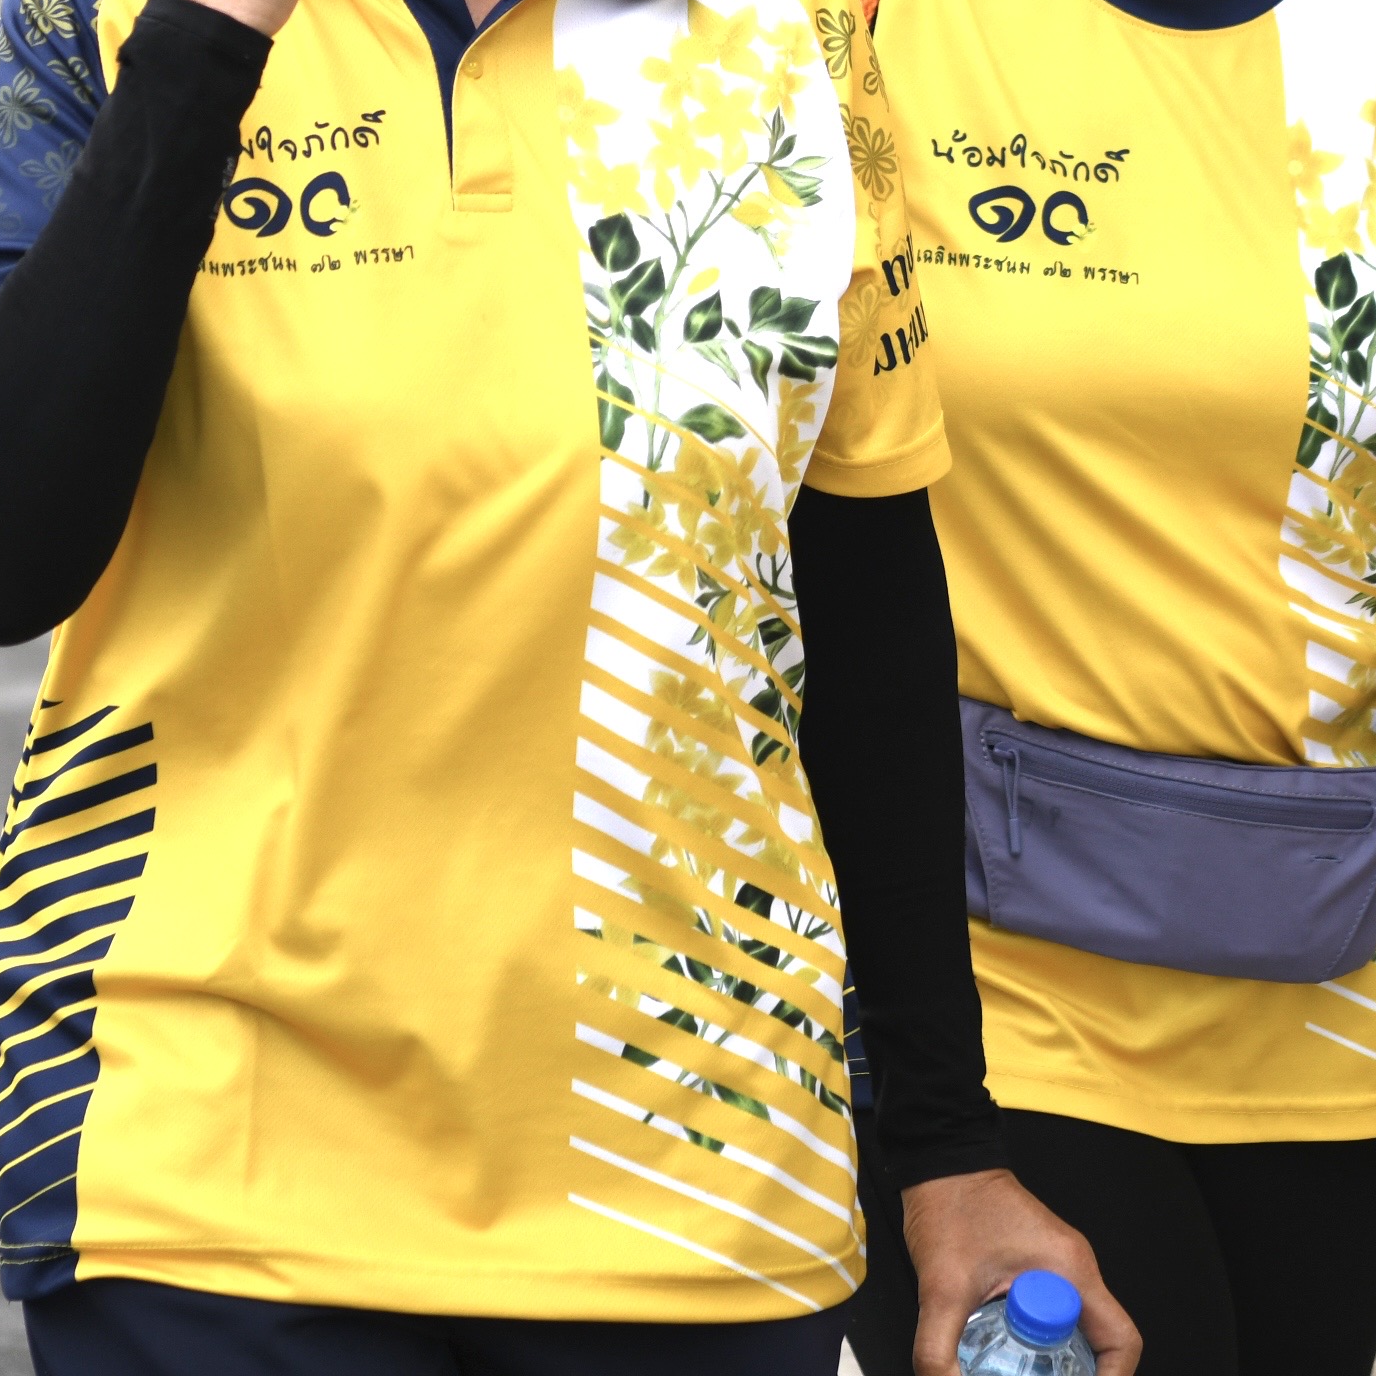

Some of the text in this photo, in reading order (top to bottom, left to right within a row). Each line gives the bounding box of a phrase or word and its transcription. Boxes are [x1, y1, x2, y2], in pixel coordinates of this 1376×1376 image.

[309, 253, 342, 274] ๗๒
[352, 244, 415, 266] พรรษา
[915, 244, 1140, 286] เฉลิมพระชนม ๗๒ พรรษา
